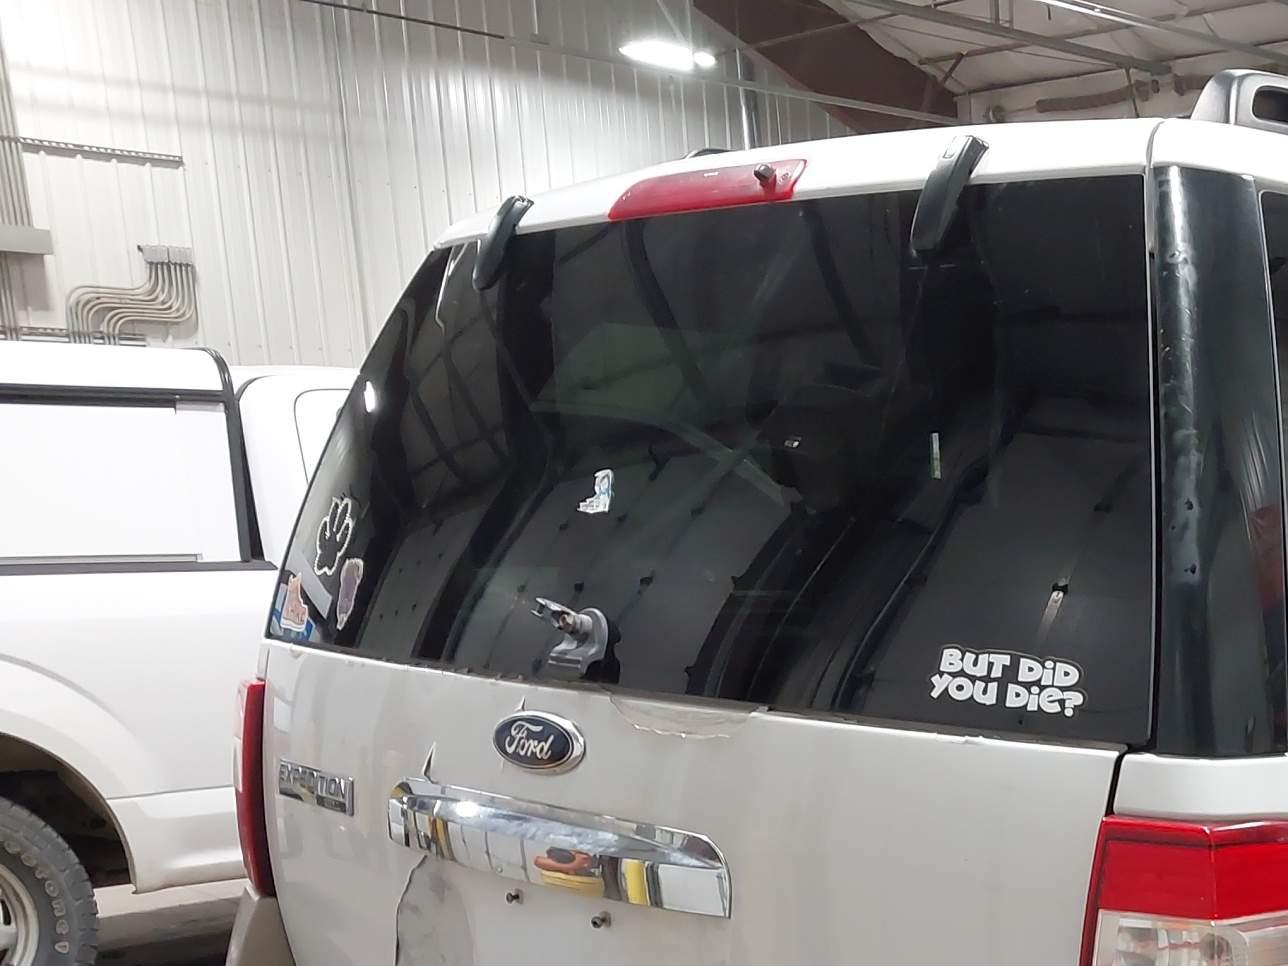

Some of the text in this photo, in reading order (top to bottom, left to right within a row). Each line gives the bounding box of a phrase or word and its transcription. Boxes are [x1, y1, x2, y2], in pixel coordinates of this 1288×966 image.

[940, 648, 1011, 678] BUT
[930, 673, 998, 706] YOU
[505, 720, 555, 760] Ford
